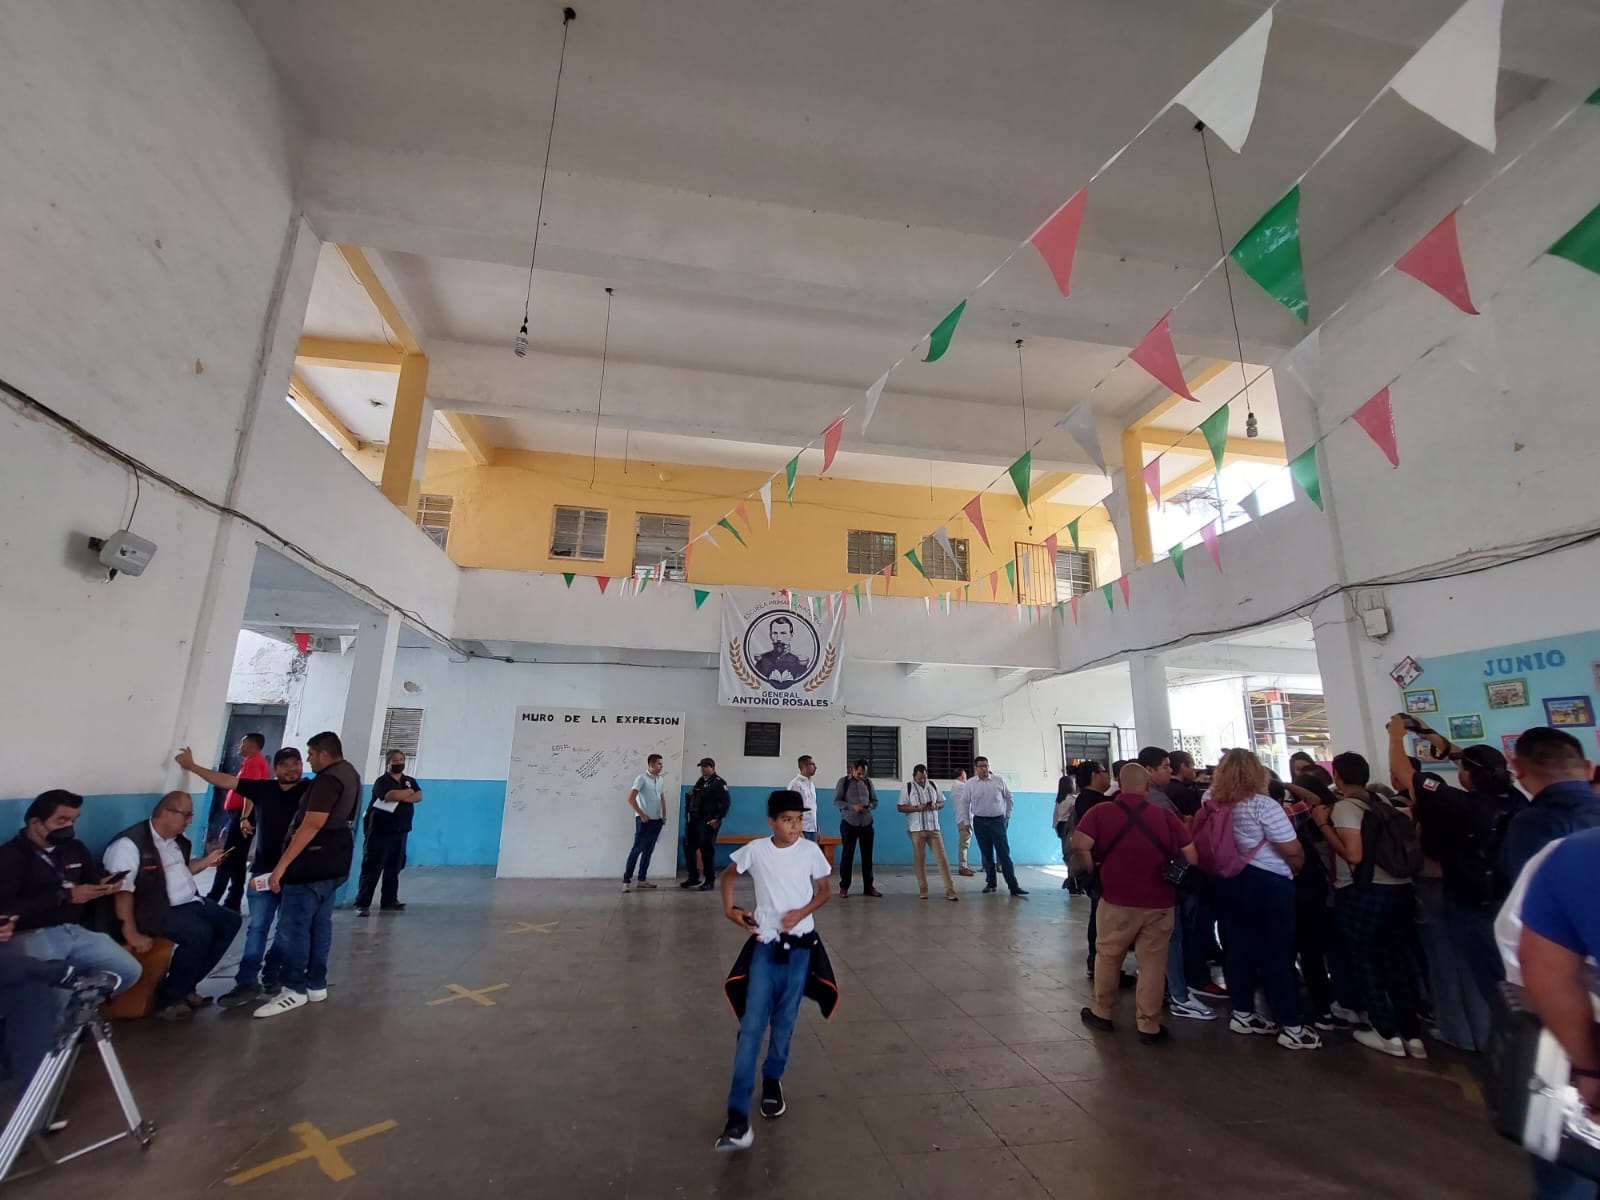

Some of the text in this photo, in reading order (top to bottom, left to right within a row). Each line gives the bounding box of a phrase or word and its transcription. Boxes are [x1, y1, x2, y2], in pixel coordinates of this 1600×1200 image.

[1483, 649, 1566, 676] JUNIO
[761, 691, 800, 699] GENERAL
[732, 696, 829, 707] ANTONIO ROSALES
[522, 713, 680, 725] MURO DE LA EXPRESION
